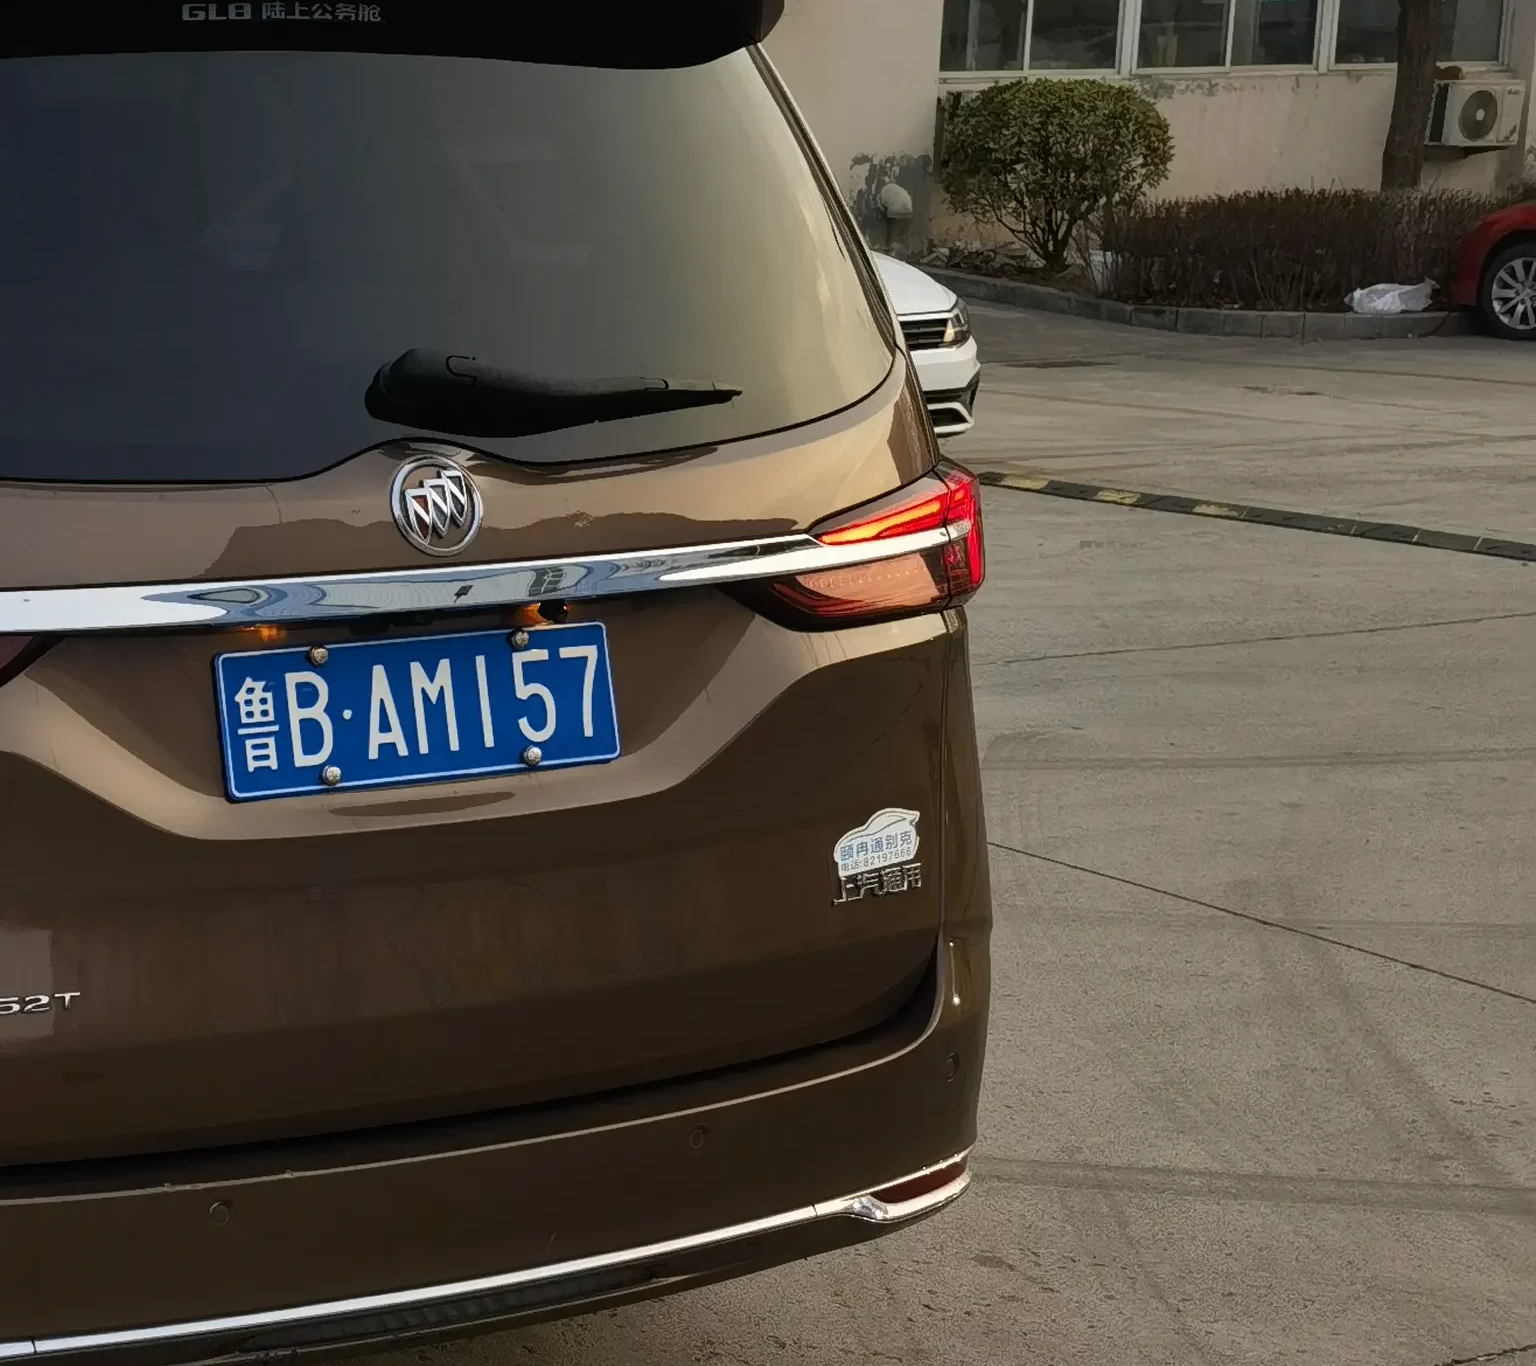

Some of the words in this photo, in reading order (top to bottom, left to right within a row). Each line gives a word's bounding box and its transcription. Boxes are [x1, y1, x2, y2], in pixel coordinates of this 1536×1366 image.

[181, 2, 252, 21] GL8
[261, 1, 382, 23] 陆上公务舱
[233, 644, 599, 773] 鲁B·AM157
